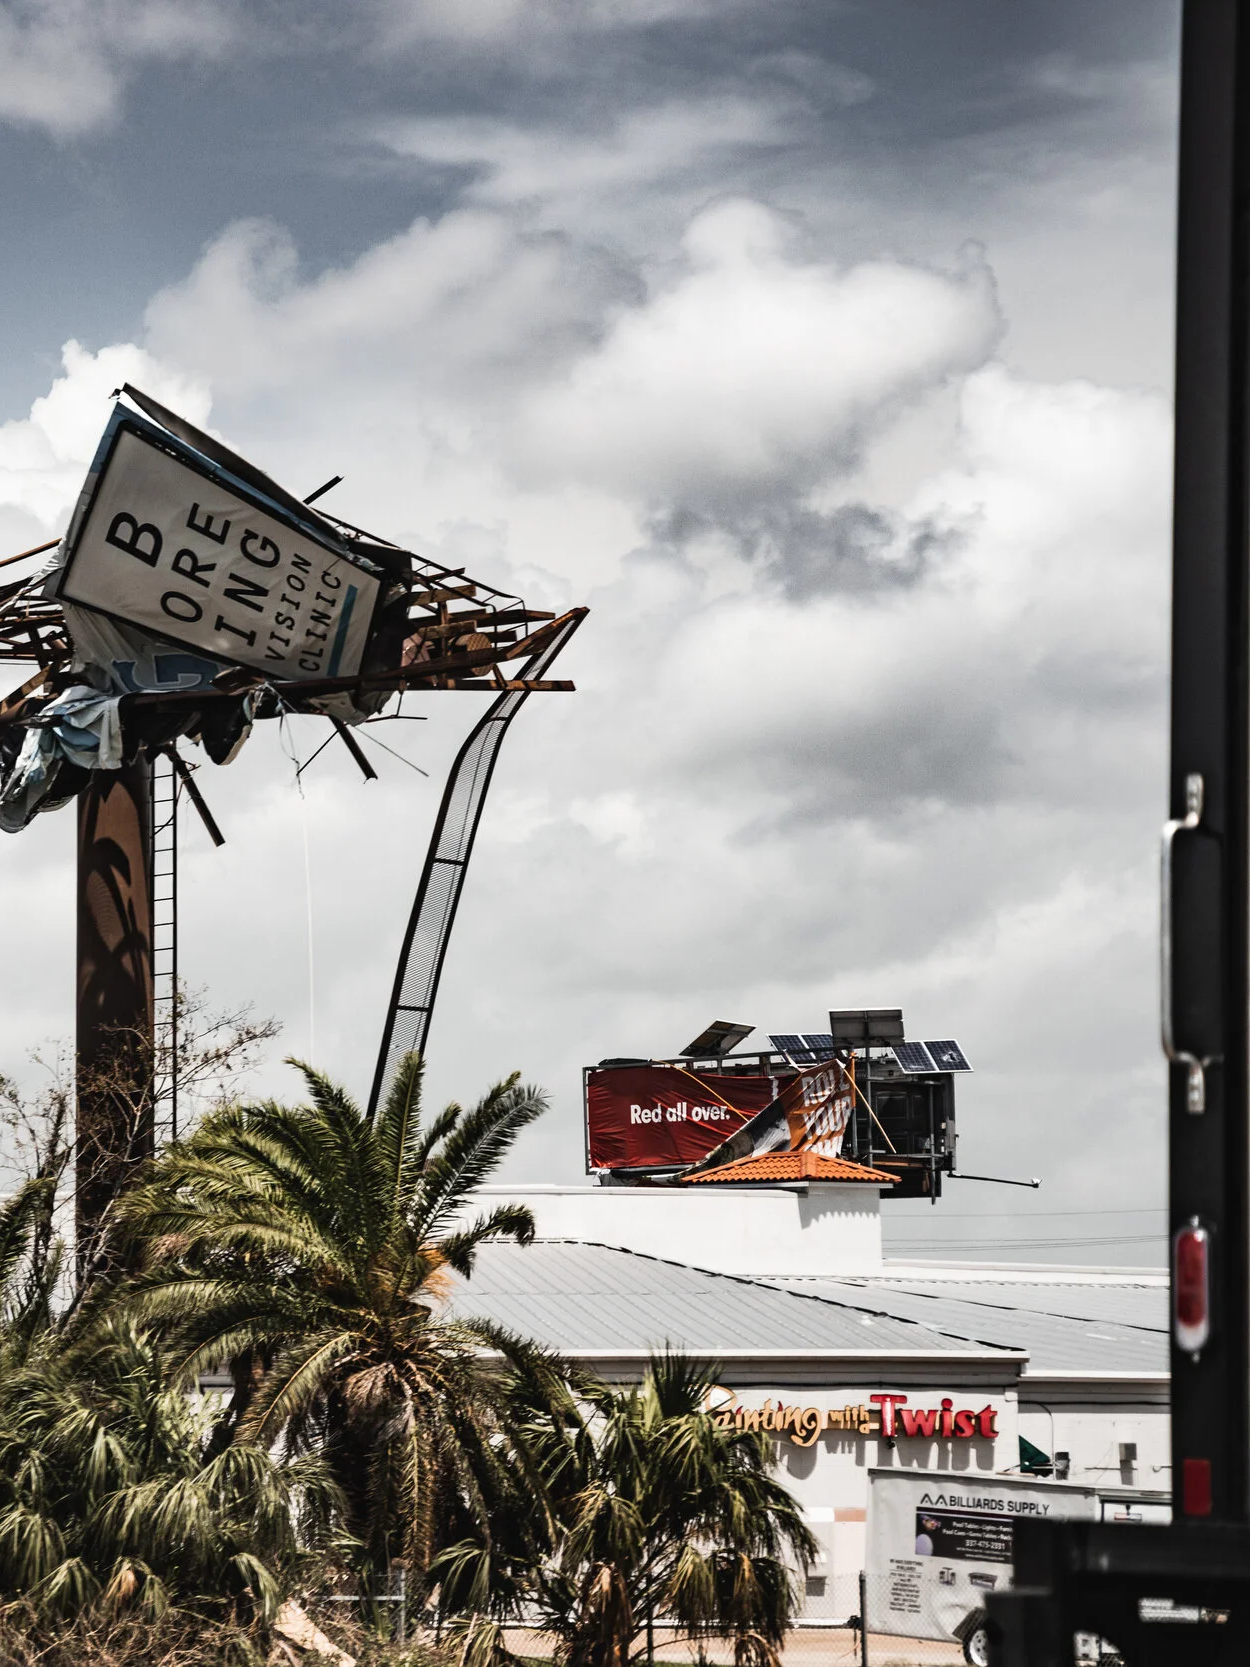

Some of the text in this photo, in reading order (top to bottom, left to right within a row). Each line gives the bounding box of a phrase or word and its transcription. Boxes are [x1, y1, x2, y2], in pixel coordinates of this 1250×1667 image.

[105, 511, 165, 568] B
[263, 552, 312, 662] VISION
[299, 570, 342, 672] CLINIC
[630, 1102, 730, 1124] Red all over.
[829, 1405, 870, 1422] with
[870, 1394, 999, 1438] Twist
[949, 1495, 1004, 1511] BILLIARDS
[1007, 1500, 1050, 1515] SUPPLY
